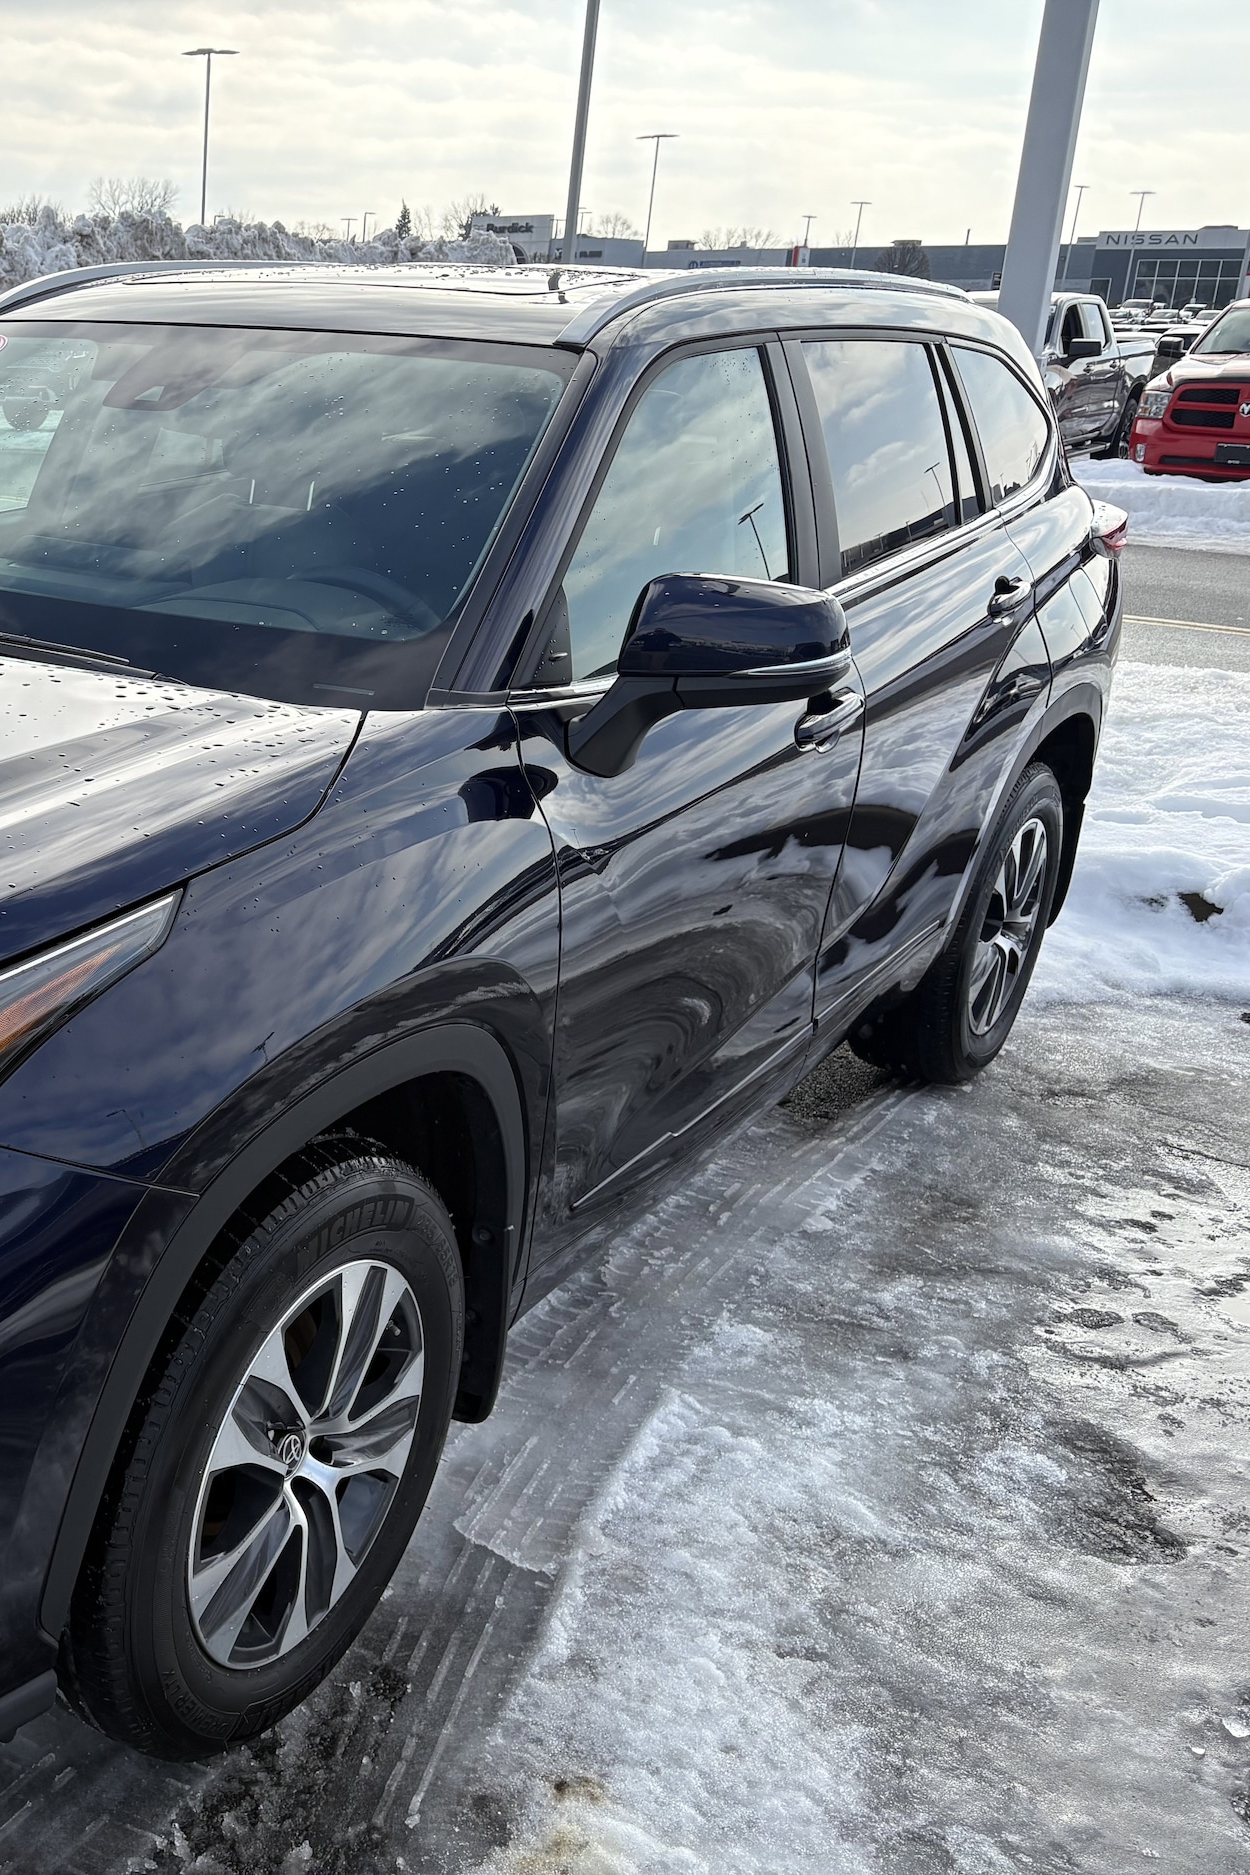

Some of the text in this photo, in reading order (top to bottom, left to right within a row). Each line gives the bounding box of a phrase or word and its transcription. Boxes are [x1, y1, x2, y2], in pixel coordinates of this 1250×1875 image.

[486, 222, 534, 234] Burdick
[1106, 233, 1199, 246] NISSAN
[296, 1199, 410, 1277] MICHELIN
[161, 1669, 231, 1735] PREMIER LTX
